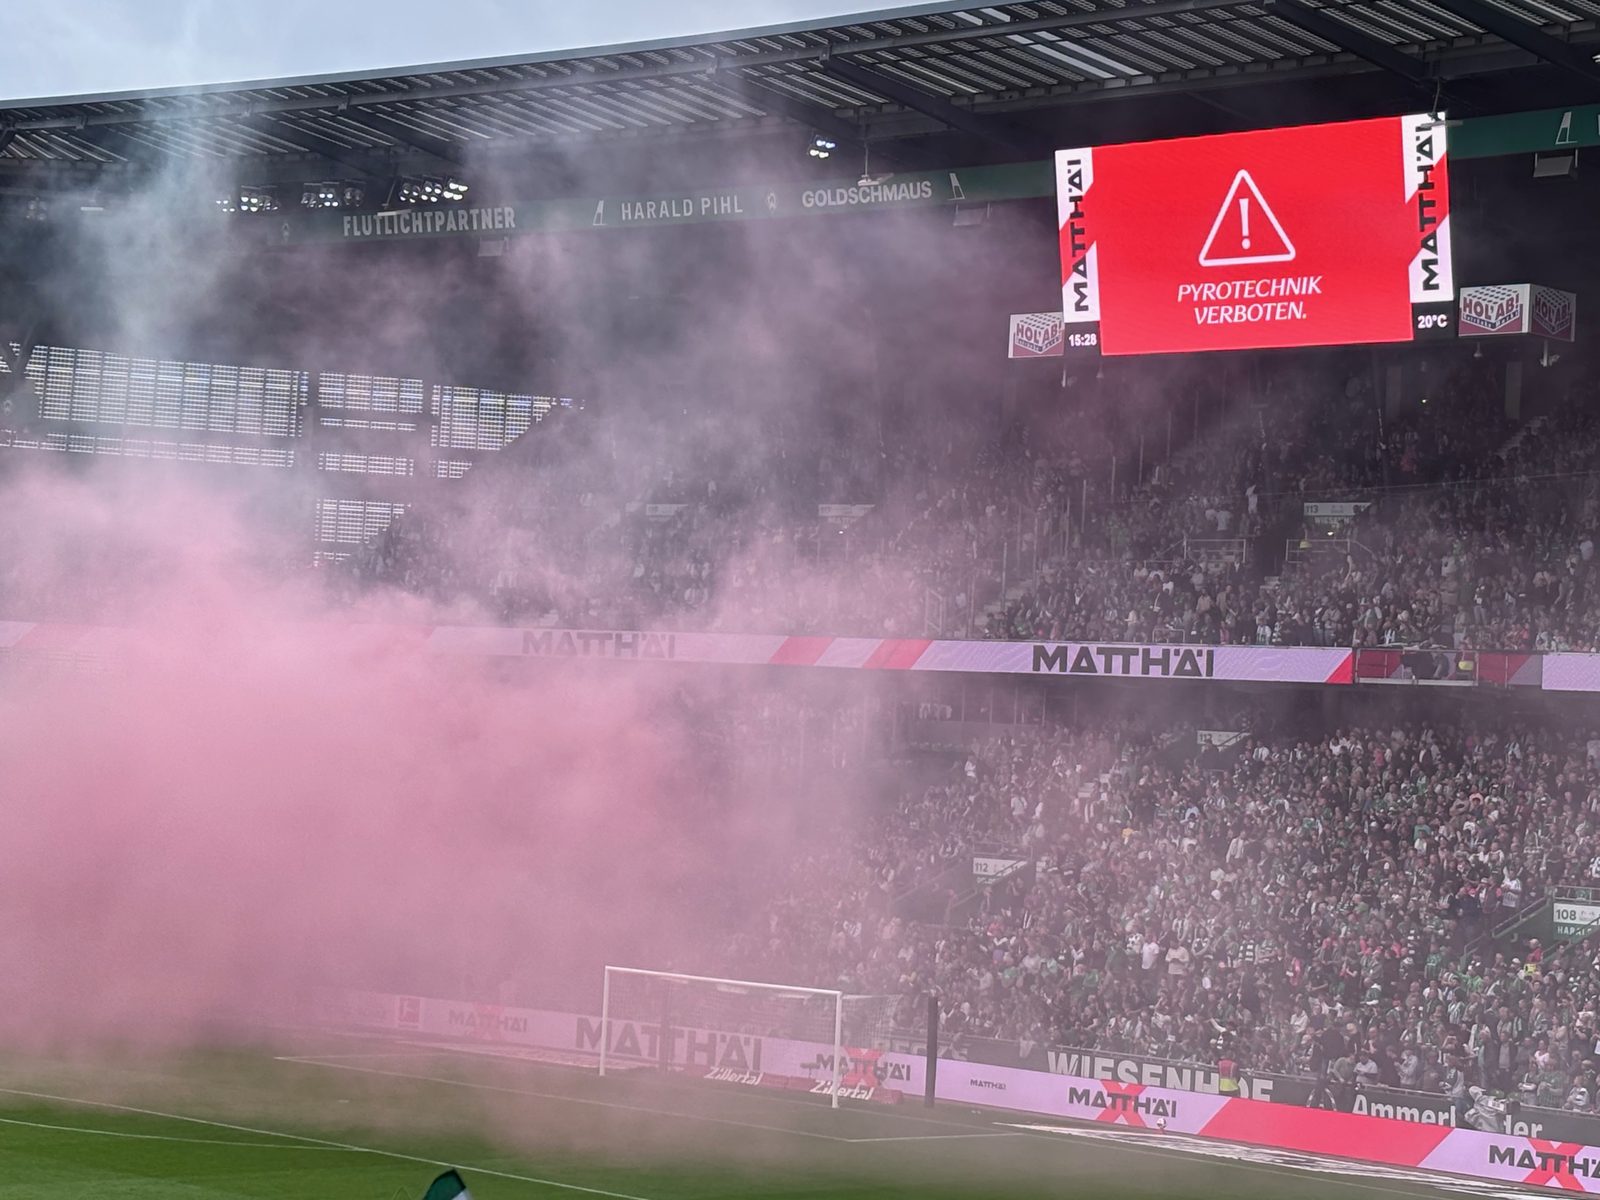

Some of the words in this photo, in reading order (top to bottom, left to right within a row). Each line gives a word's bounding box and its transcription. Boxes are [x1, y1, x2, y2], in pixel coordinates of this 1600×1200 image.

[622, 199, 693, 220] HARALD
[701, 195, 743, 215] PIHL
[802, 181, 932, 208] GOLDSCHMAUS
[343, 207, 515, 237] FLUTLICHTPARTNER
[1067, 159, 1089, 312] MATTHÄI
[1178, 276, 1322, 302] PYROTECHNIK
[1195, 301, 1307, 325] VERBOTEN.
[1417, 314, 1447, 329] 20°C
[1069, 333, 1097, 347] 15:28
[521, 630, 675, 659] MATTHÄI
[1032, 645, 1214, 677] MATTHÄI
[975, 862, 988, 873] 112
[1556, 909, 1577, 921] 108
[576, 1017, 761, 1071] MATTHÄI
[704, 1066, 764, 1086] Zillertal
[1068, 1087, 1176, 1118] MATTHÄI
